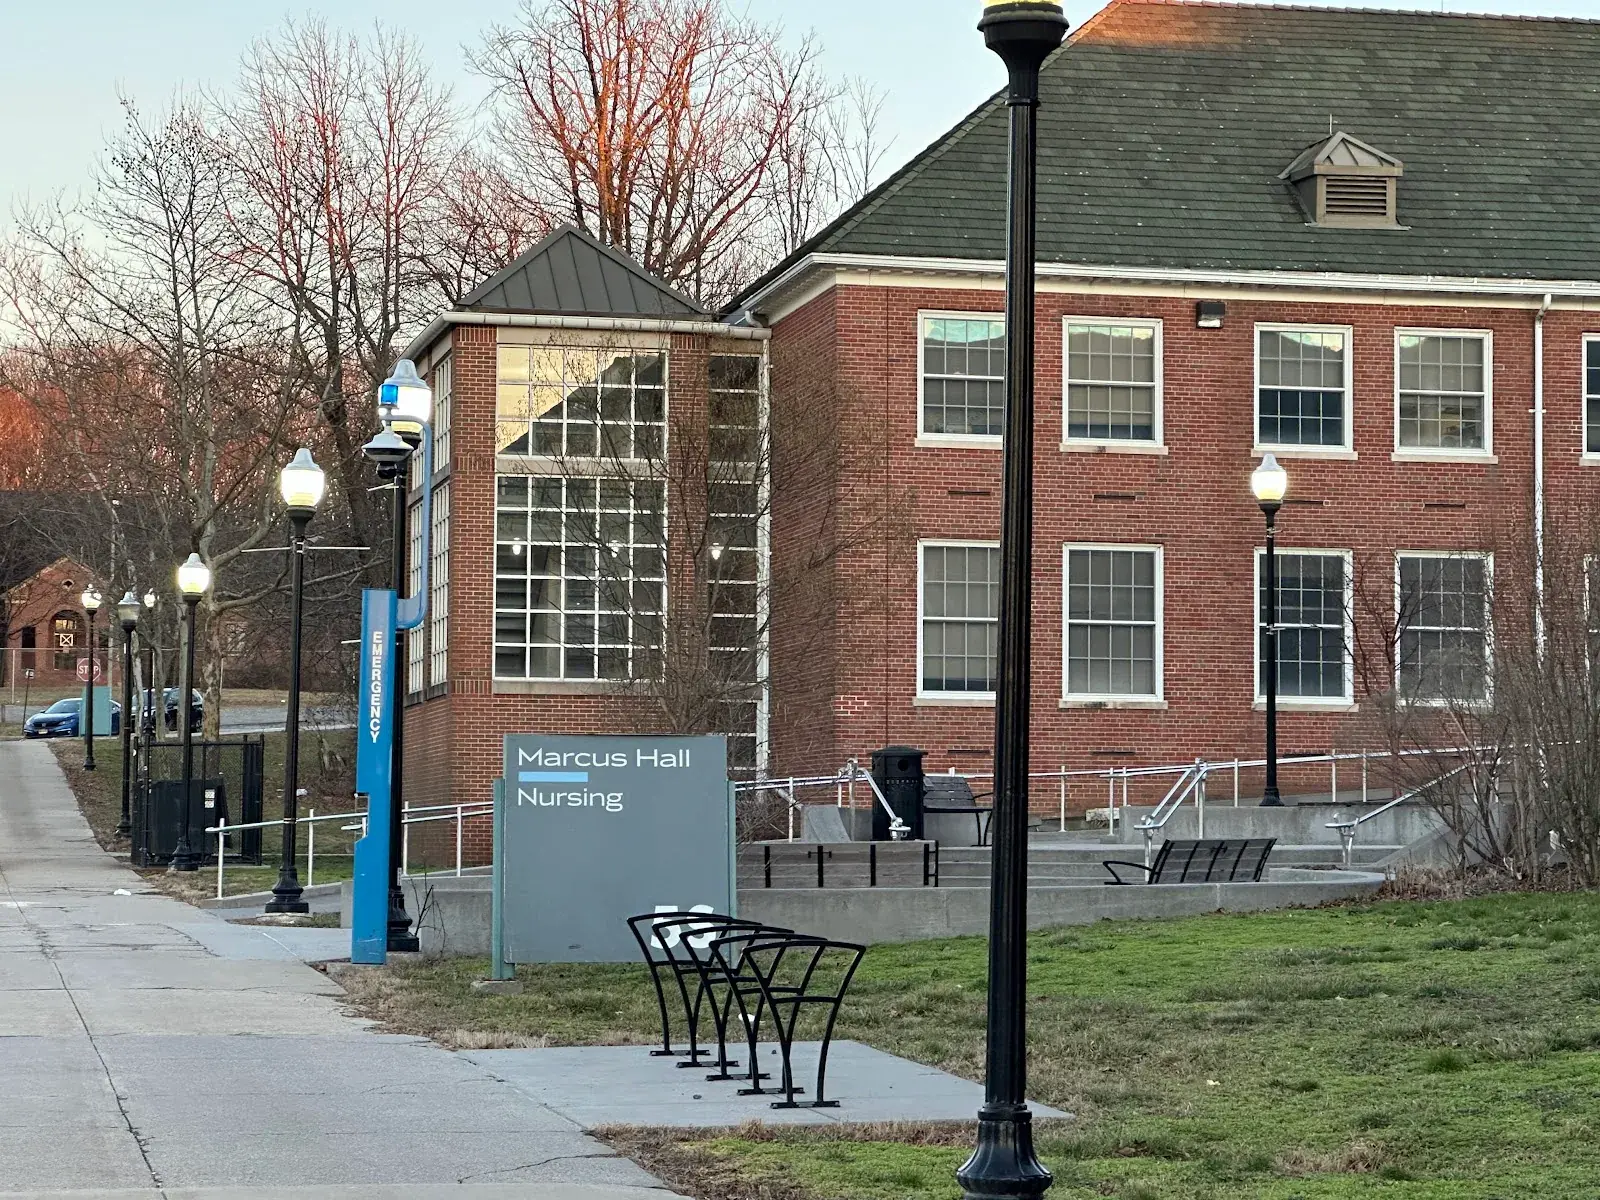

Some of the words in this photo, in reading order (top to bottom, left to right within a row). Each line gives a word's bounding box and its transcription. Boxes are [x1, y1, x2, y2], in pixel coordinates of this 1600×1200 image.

[78, 665, 99, 675] STP
[369, 631, 383, 744] EMERGENCY
[518, 747, 628, 767] Marcus
[636, 748, 690, 767] Hall
[517, 787, 624, 812] Nursing
